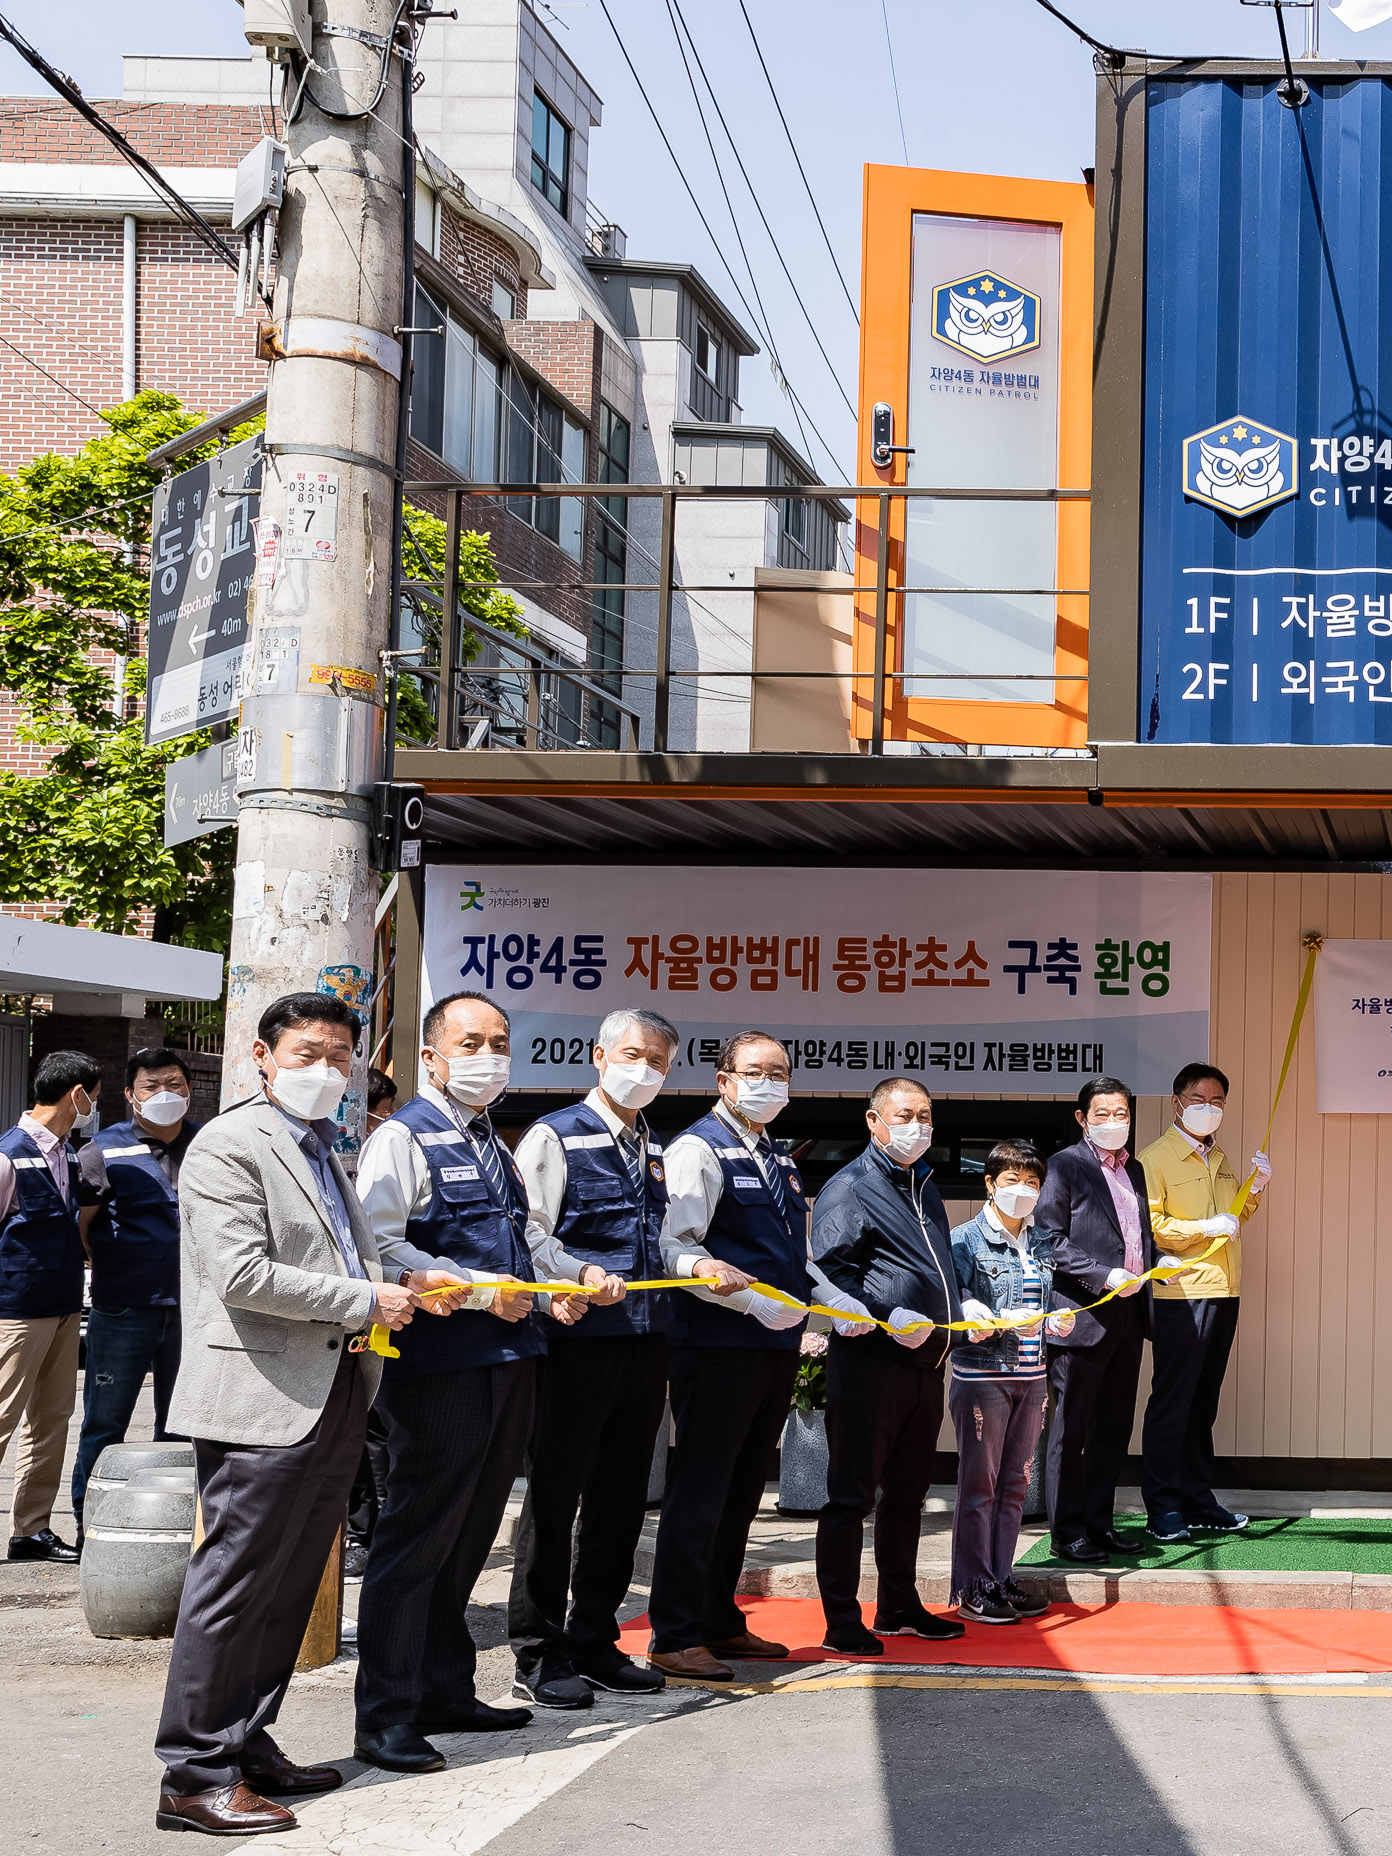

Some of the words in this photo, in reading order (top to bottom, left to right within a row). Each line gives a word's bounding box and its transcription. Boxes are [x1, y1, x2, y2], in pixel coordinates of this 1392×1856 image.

[930, 366, 975, 383] 자양4동
[979, 370, 1040, 390] 자율방범대
[929, 384, 982, 396] CITIZEN
[989, 389, 1040, 401] PATROL
[289, 482, 337, 495] 0324D
[297, 493, 323, 504] 891
[303, 509, 316, 533] 7
[155, 495, 252, 596] 동성교
[157, 587, 222, 627] www.dspch.or.kr
[1184, 596, 1231, 634] 1F
[221, 618, 242, 637] 40m
[266, 663, 276, 681] 7
[1181, 662, 1230, 700] 2F
[198, 680, 218, 712] 동성
[223, 670, 251, 702] 어린
[488, 897, 531, 908] 가치더하기
[532, 897, 550, 908] 광진
[459, 933, 608, 991] 자양4동
[624, 934, 820, 993] 자율방범대
[832, 935, 991, 995] 통합초소
[1003, 938, 1083, 996] 구축
[1093, 939, 1171, 998] 환영
[982, 1041, 1104, 1073] 자율방범대
